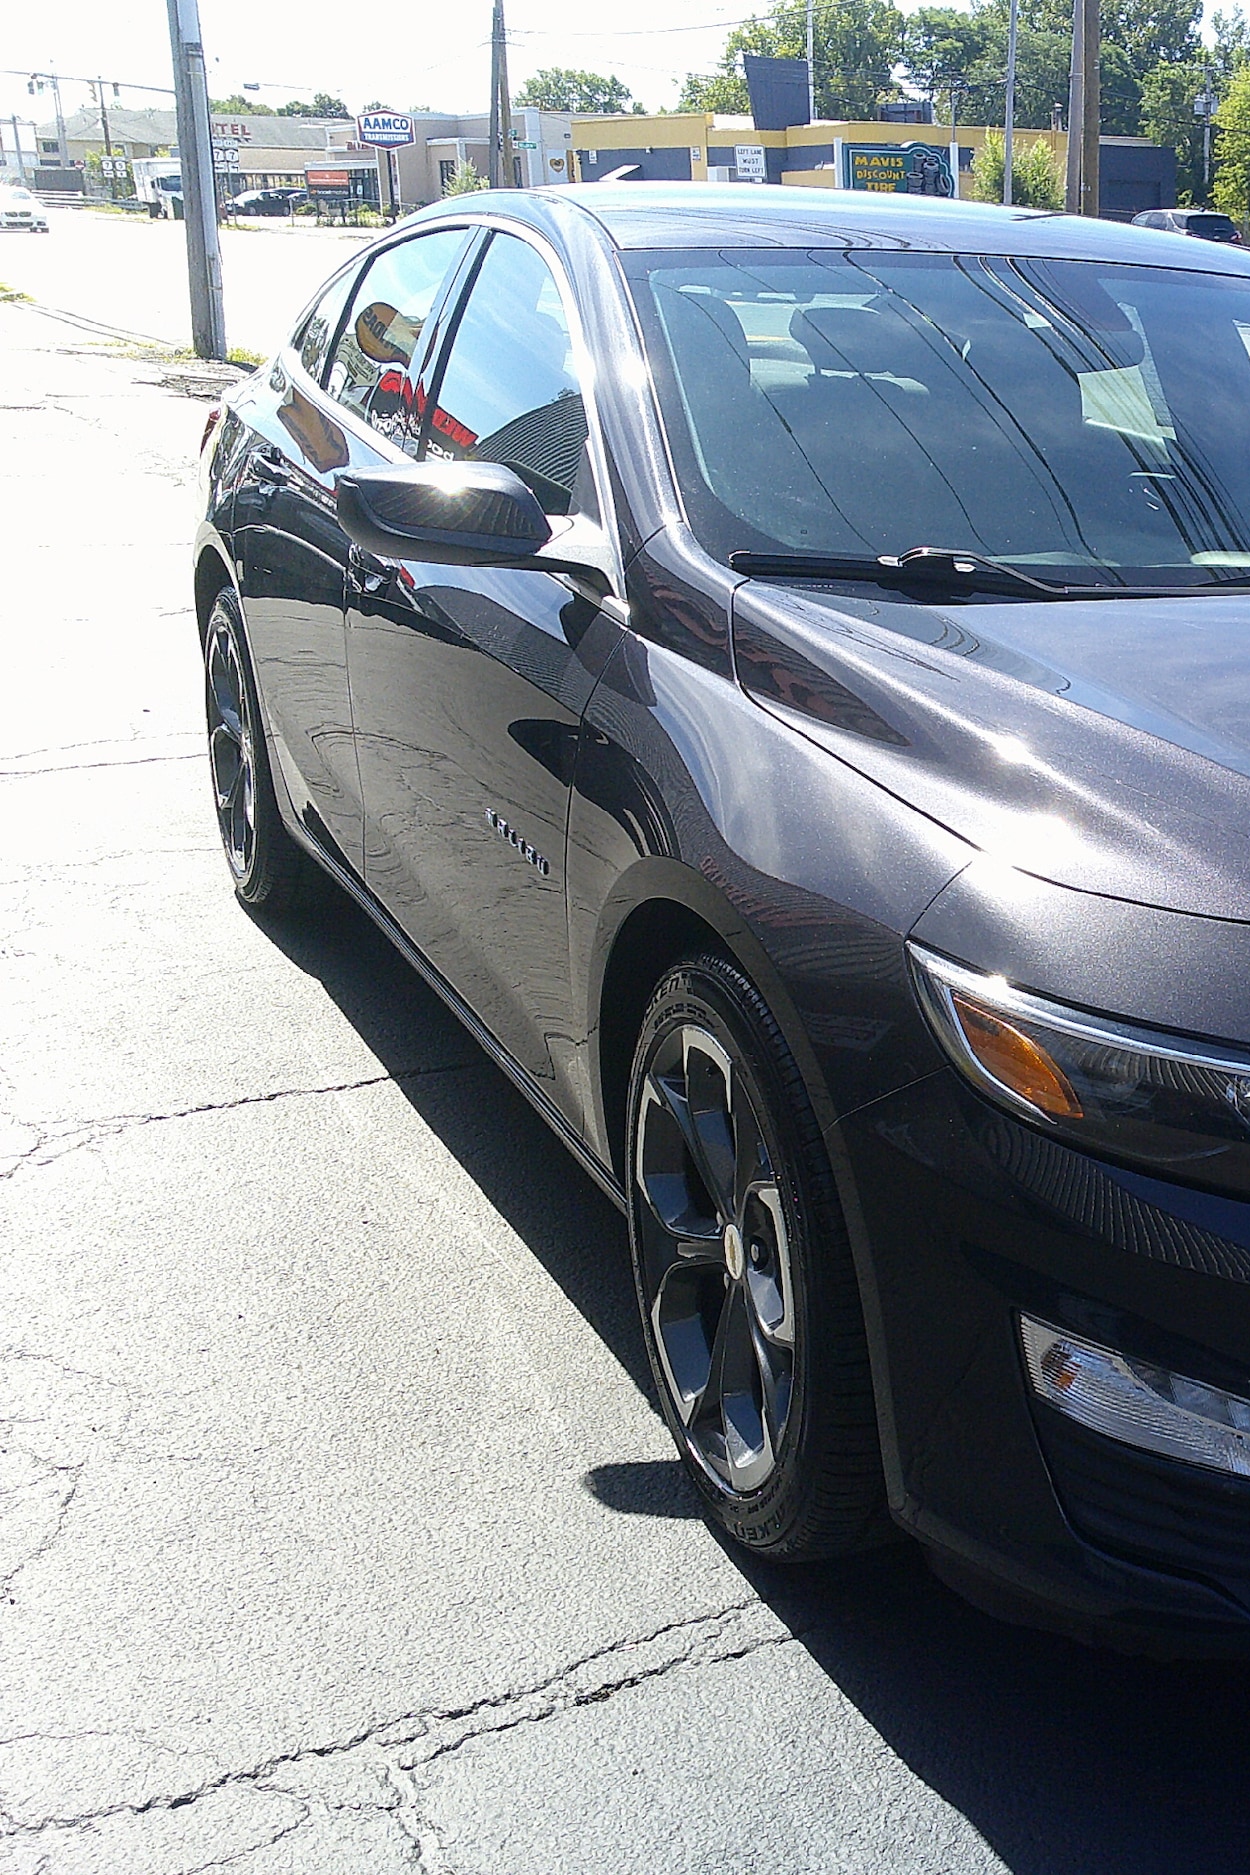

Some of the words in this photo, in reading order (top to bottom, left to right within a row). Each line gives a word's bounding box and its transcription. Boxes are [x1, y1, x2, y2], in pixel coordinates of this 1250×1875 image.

[363, 117, 409, 130] AAMCO
[854, 156, 904, 167] MAVIS
[856, 169, 906, 180] DISCOUNT
[865, 182, 897, 192] TIRE
